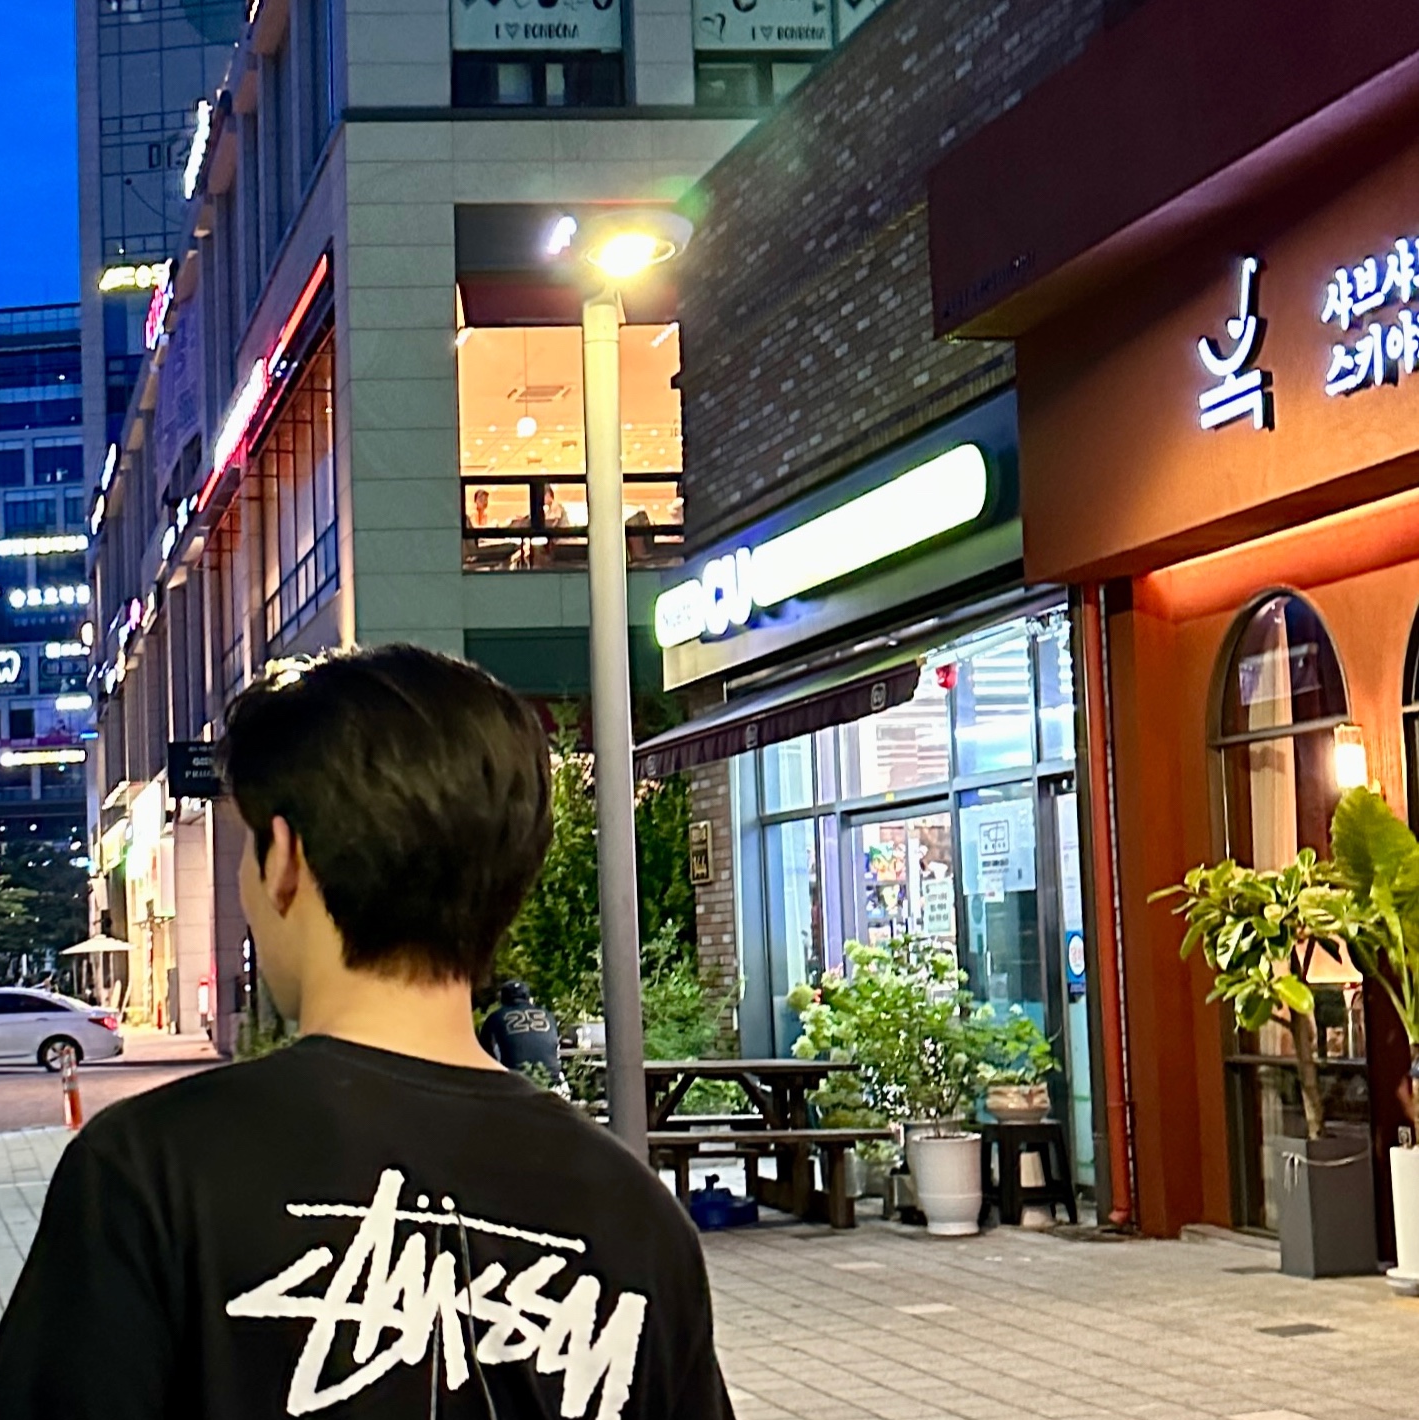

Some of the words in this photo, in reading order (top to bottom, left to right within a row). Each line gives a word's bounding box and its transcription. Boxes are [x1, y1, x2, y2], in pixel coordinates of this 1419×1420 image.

[1321, 237, 1419, 331] 샤브샤
[1325, 309, 1419, 397] 스키야
[504, 1008, 551, 1035] 25
